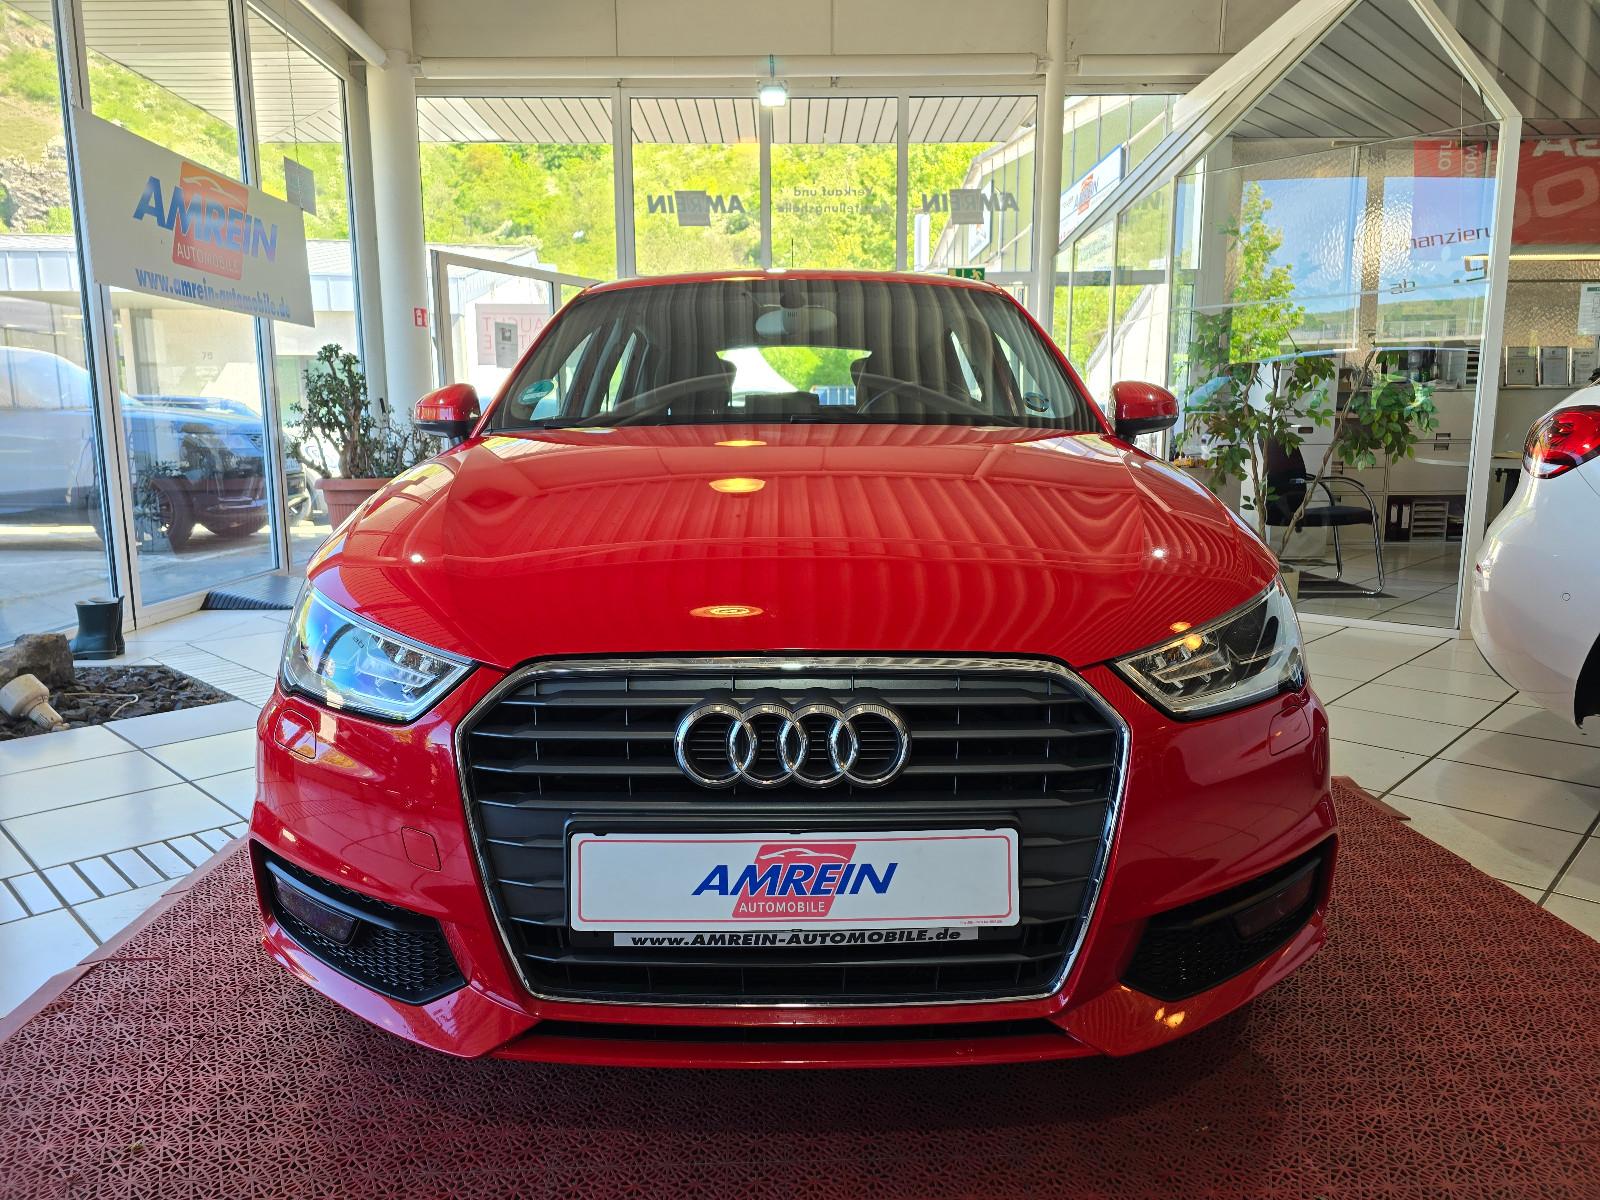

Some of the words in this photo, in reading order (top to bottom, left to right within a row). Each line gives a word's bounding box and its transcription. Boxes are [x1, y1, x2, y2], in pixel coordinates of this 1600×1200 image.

[133, 176, 278, 264] AMREIN
[691, 863, 899, 896] AMREIN
[739, 901, 826, 913] AUTOMOBILE
[631, 928, 961, 946] www.AMREIN-AUTOMOBILE.de
